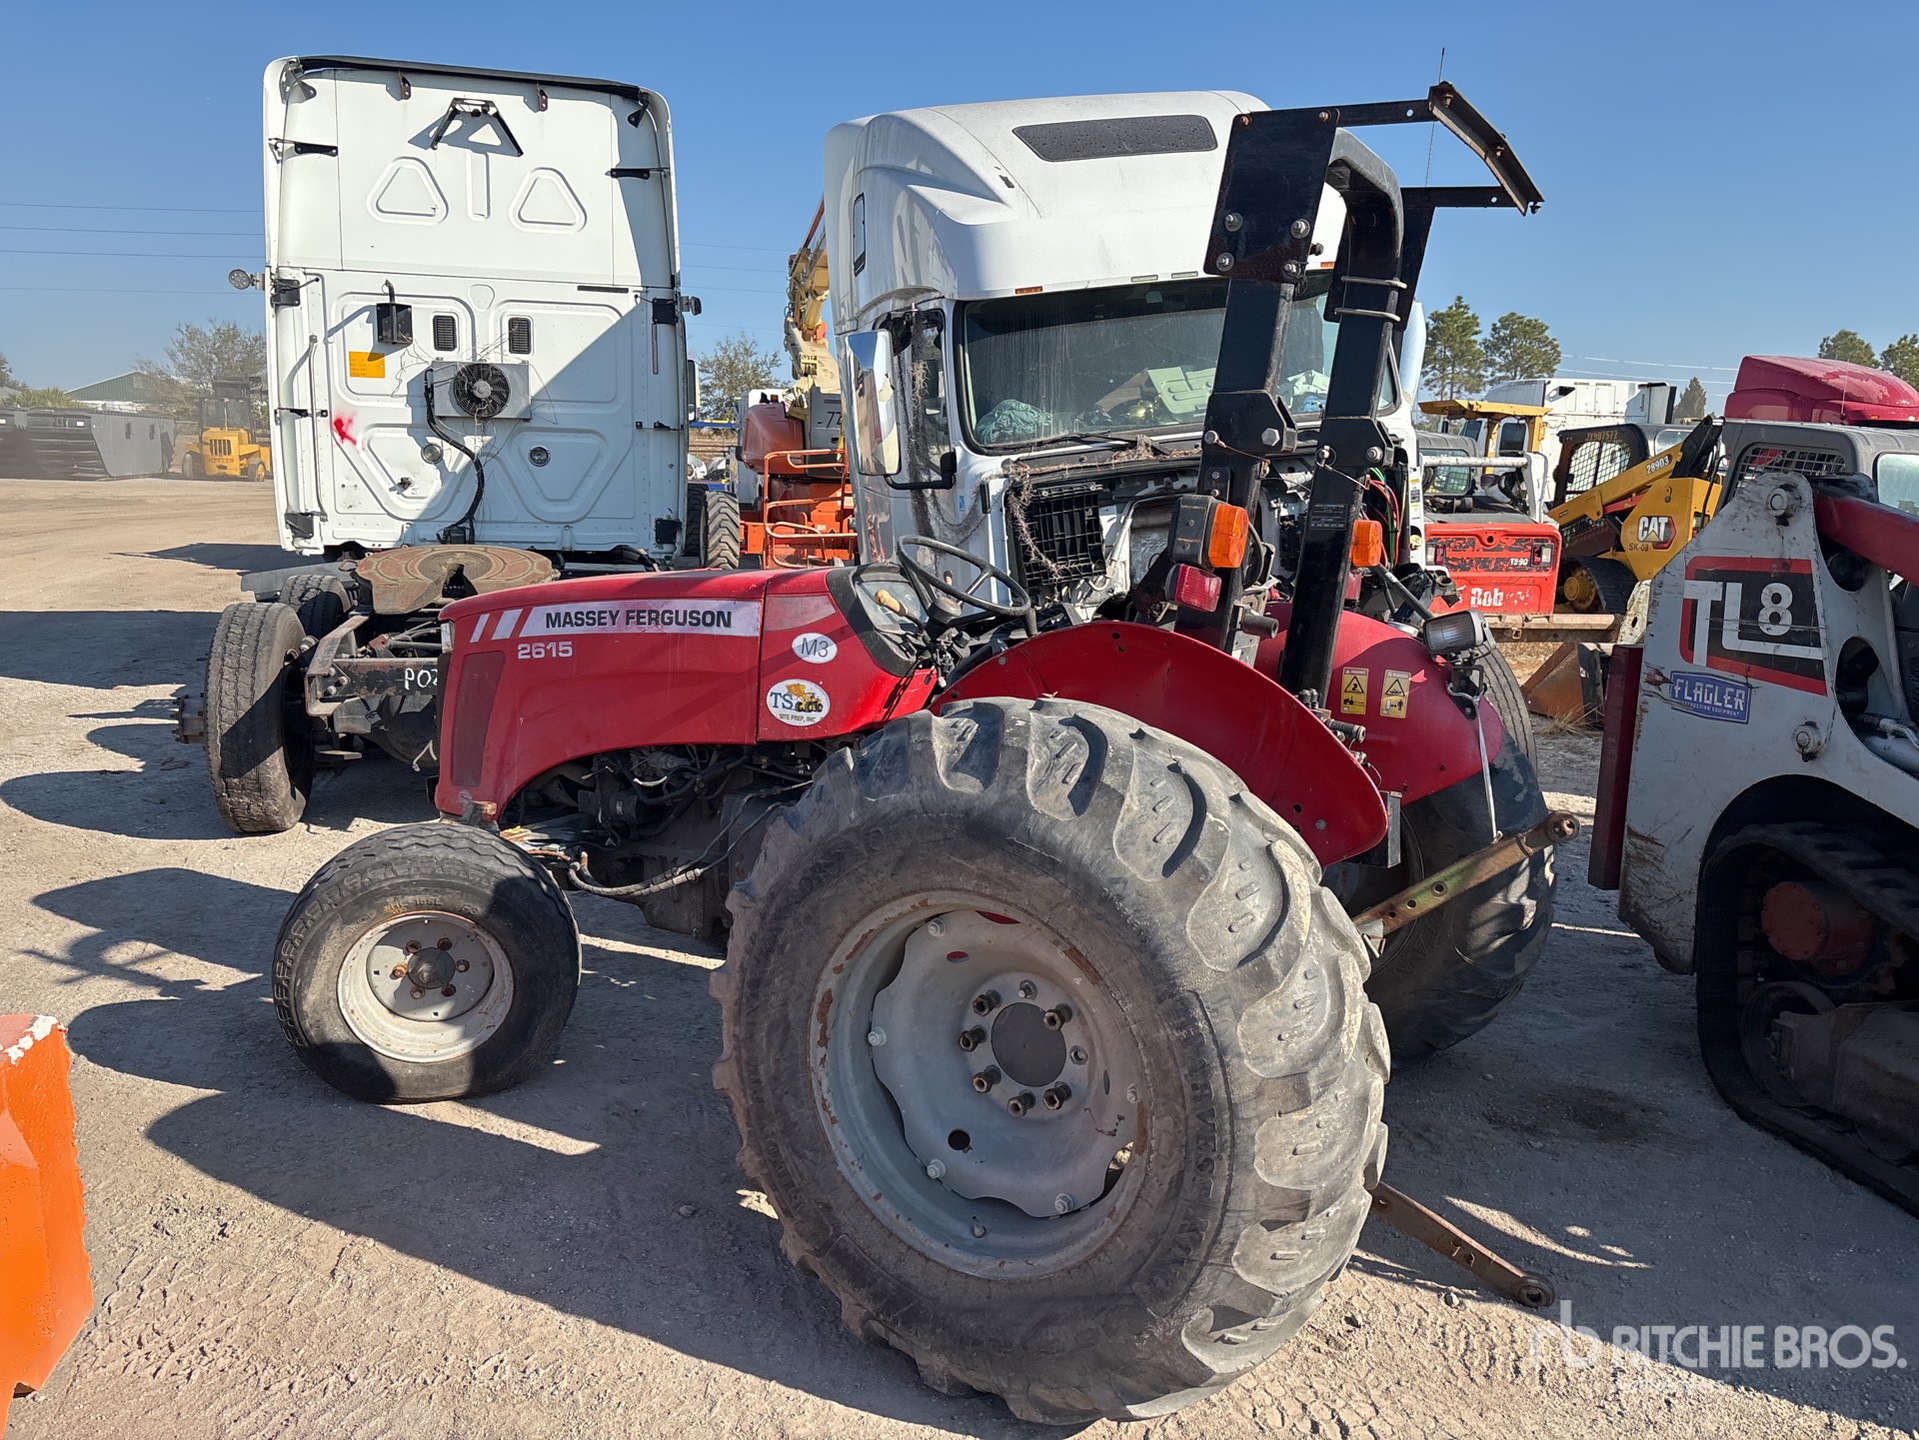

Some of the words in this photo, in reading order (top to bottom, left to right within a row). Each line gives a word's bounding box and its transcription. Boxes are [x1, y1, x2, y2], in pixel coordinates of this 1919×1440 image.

[1646, 455, 1670, 475] 28903
[1638, 516, 1669, 542] CAT
[546, 609, 620, 629] MASSEY
[625, 609, 732, 629] FERGUSON
[517, 641, 573, 660] 2615
[801, 637, 829, 658] M3
[769, 691, 794, 710] TS
[1674, 679, 1745, 711] FLAGLER
